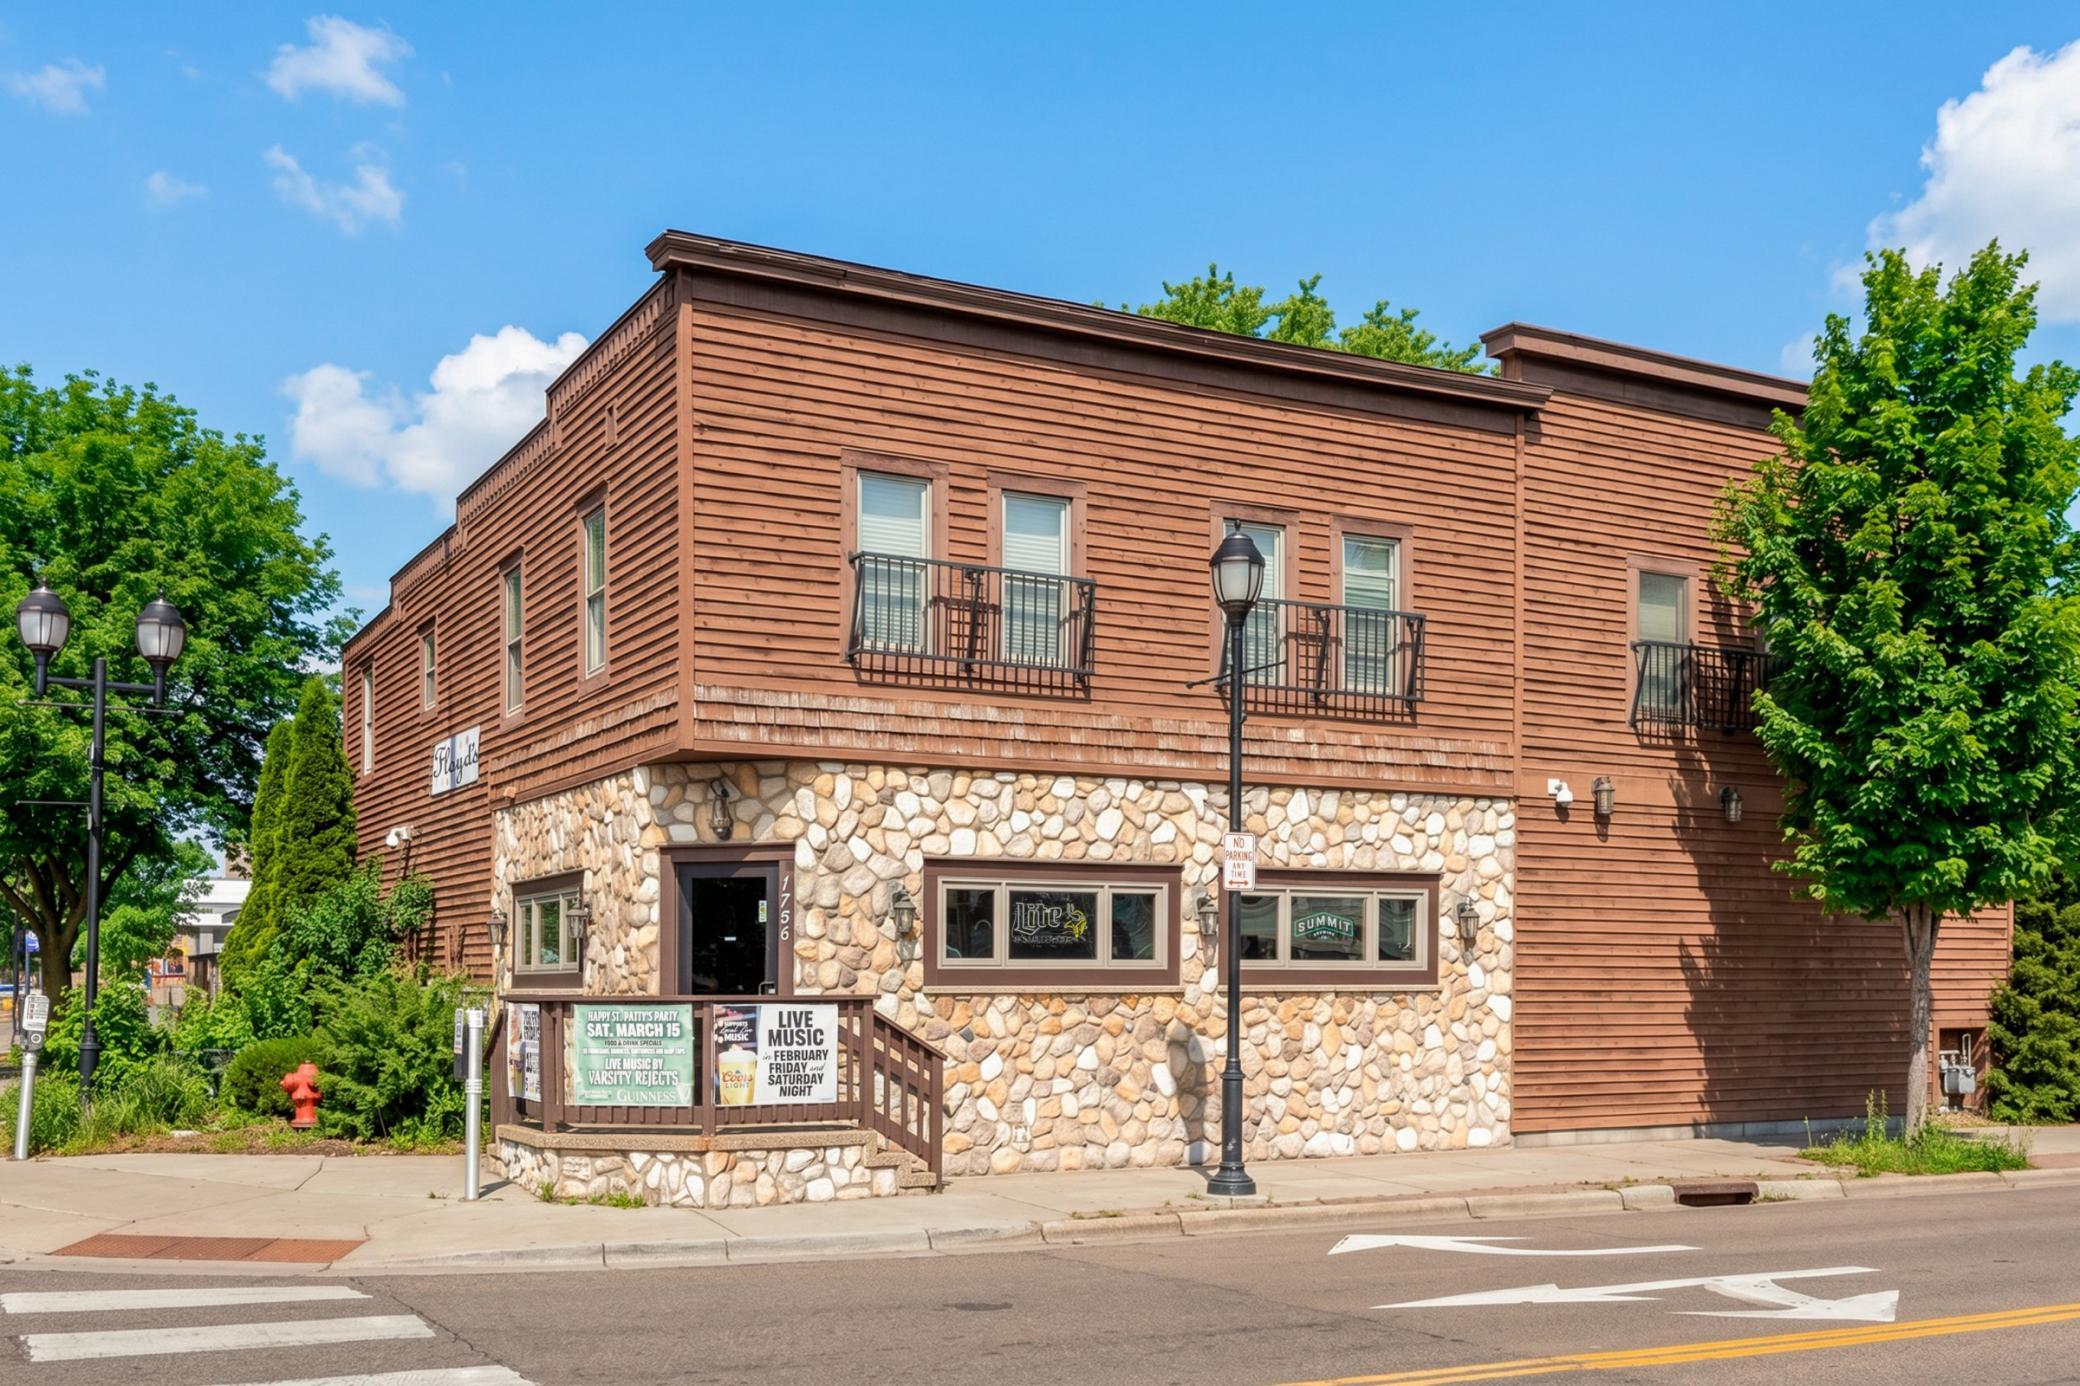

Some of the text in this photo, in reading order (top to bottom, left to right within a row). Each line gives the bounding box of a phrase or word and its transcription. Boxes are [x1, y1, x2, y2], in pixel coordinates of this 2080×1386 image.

[433, 741, 479, 785] Floyd's
[1233, 838, 1245, 849] NO
[1225, 850, 1253, 861] PARKING
[1232, 862, 1245, 870] ANY
[1231, 870, 1247, 879] TIME
[780, 875, 791, 941] 1756
[1013, 902, 1063, 936] Lite
[1297, 915, 1351, 932] SUMMIT
[588, 1010, 678, 1022] HAPPY ST. PATTY'S PARTY
[778, 1010, 814, 1028] LIVE
[587, 1022, 680, 1038] SAT. MARCH 15
[724, 1033, 749, 1041] MUSIC
[768, 1028, 824, 1047] MUSIC
[774, 1049, 829, 1062] FEBRUARY
[605, 1058, 664, 1070] LIVE MUSIC BY
[769, 1062, 826, 1074] FRIDAY and
[588, 1070, 679, 1087] VARSITY REJECTS
[722, 1070, 753, 1083] Coors
[768, 1073, 824, 1086] SATURDAY
[616, 1088, 678, 1102] GUINNESS
[779, 1085, 813, 1097] NIGHT
